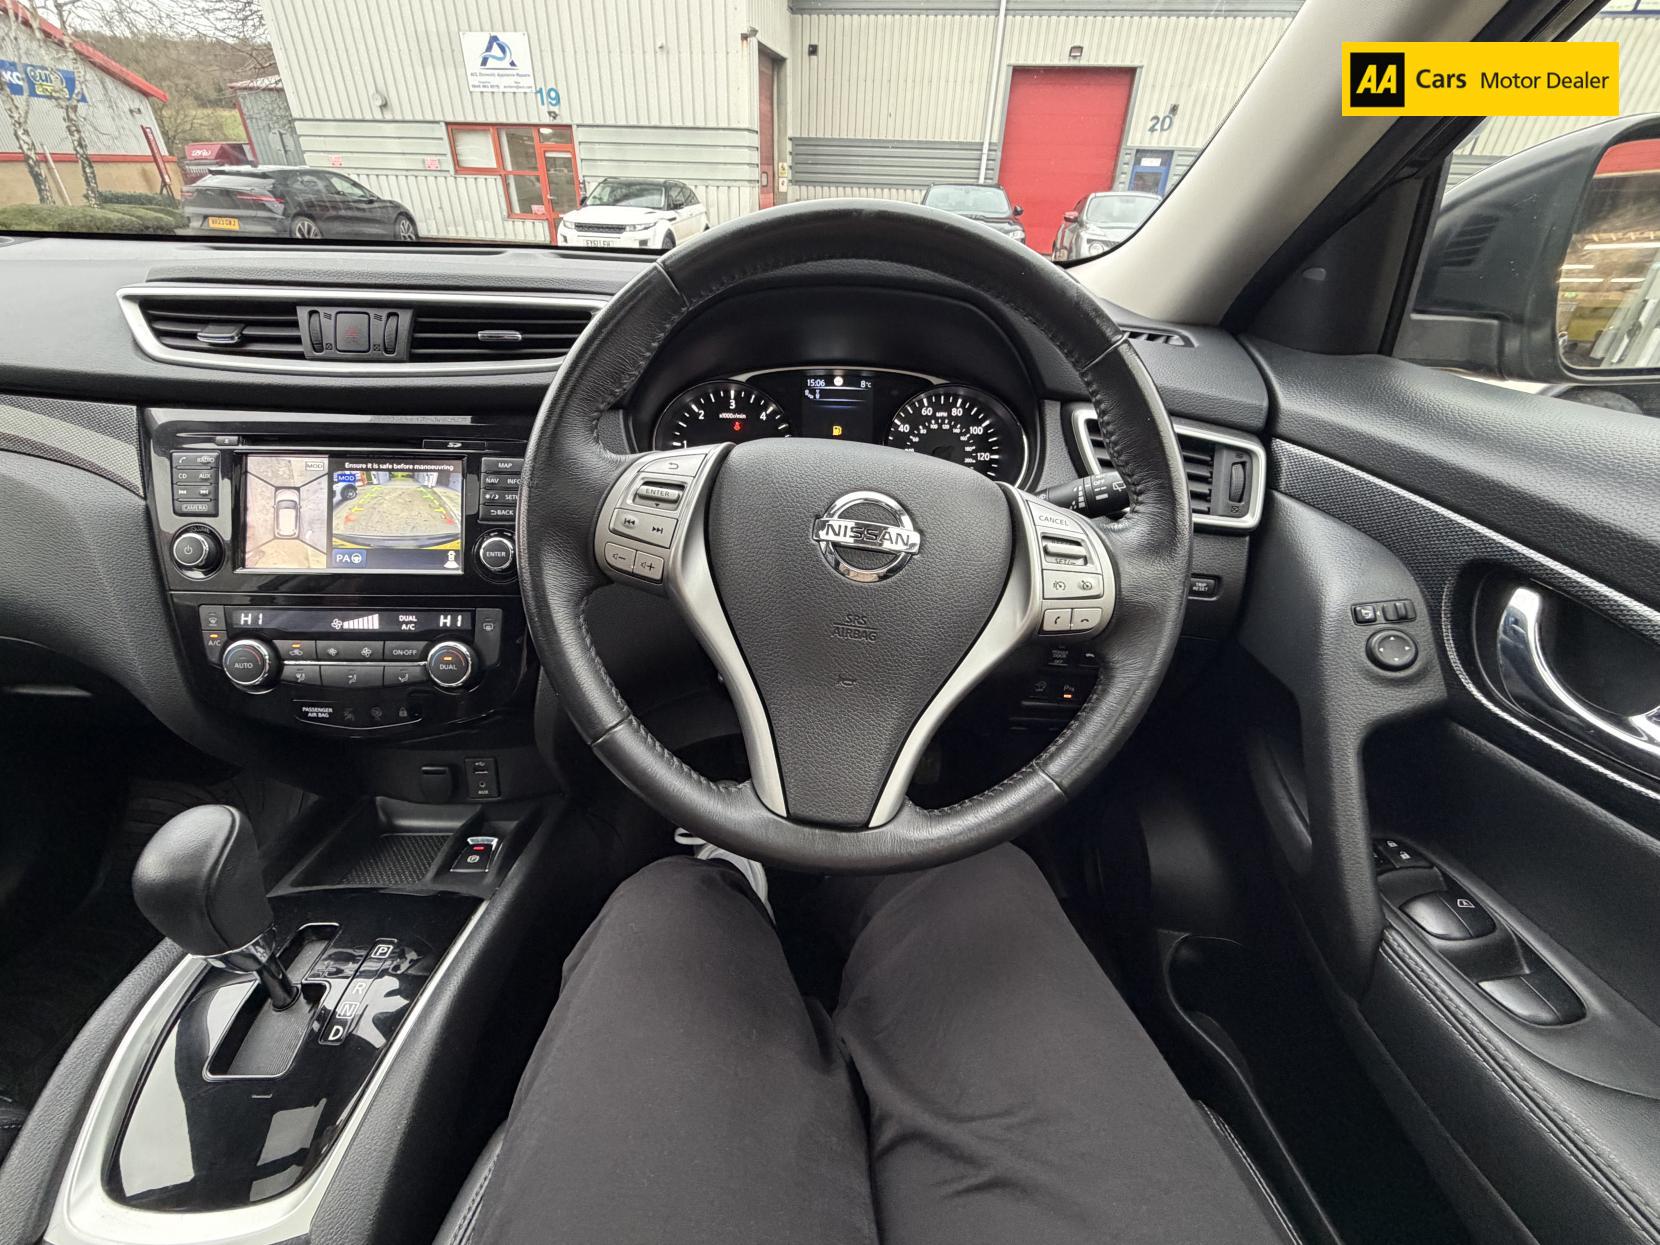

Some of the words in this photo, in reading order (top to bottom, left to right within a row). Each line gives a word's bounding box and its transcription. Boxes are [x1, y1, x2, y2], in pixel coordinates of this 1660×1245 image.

[535, 86, 561, 107] 19
[1148, 115, 1173, 133] 20
[807, 379, 826, 387] 15:06
[729, 399, 736, 409] 3
[698, 410, 705, 420] 2
[760, 411, 767, 421] 4
[921, 407, 933, 416] 60
[951, 408, 963, 416] 80
[898, 424, 910, 433] 40
[969, 426, 984, 435] 100
[977, 452, 990, 461] 120
[645, 488, 670, 497] ENTER
[1038, 515, 1069, 527] CANCEL
[825, 523, 911, 547] NISSAN
[336, 554, 350, 563] PA
[845, 614, 868, 626] SRS
[832, 626, 878, 642] AIRBAG
[352, 982, 367, 994] R
[327, 1025, 344, 1041] D
